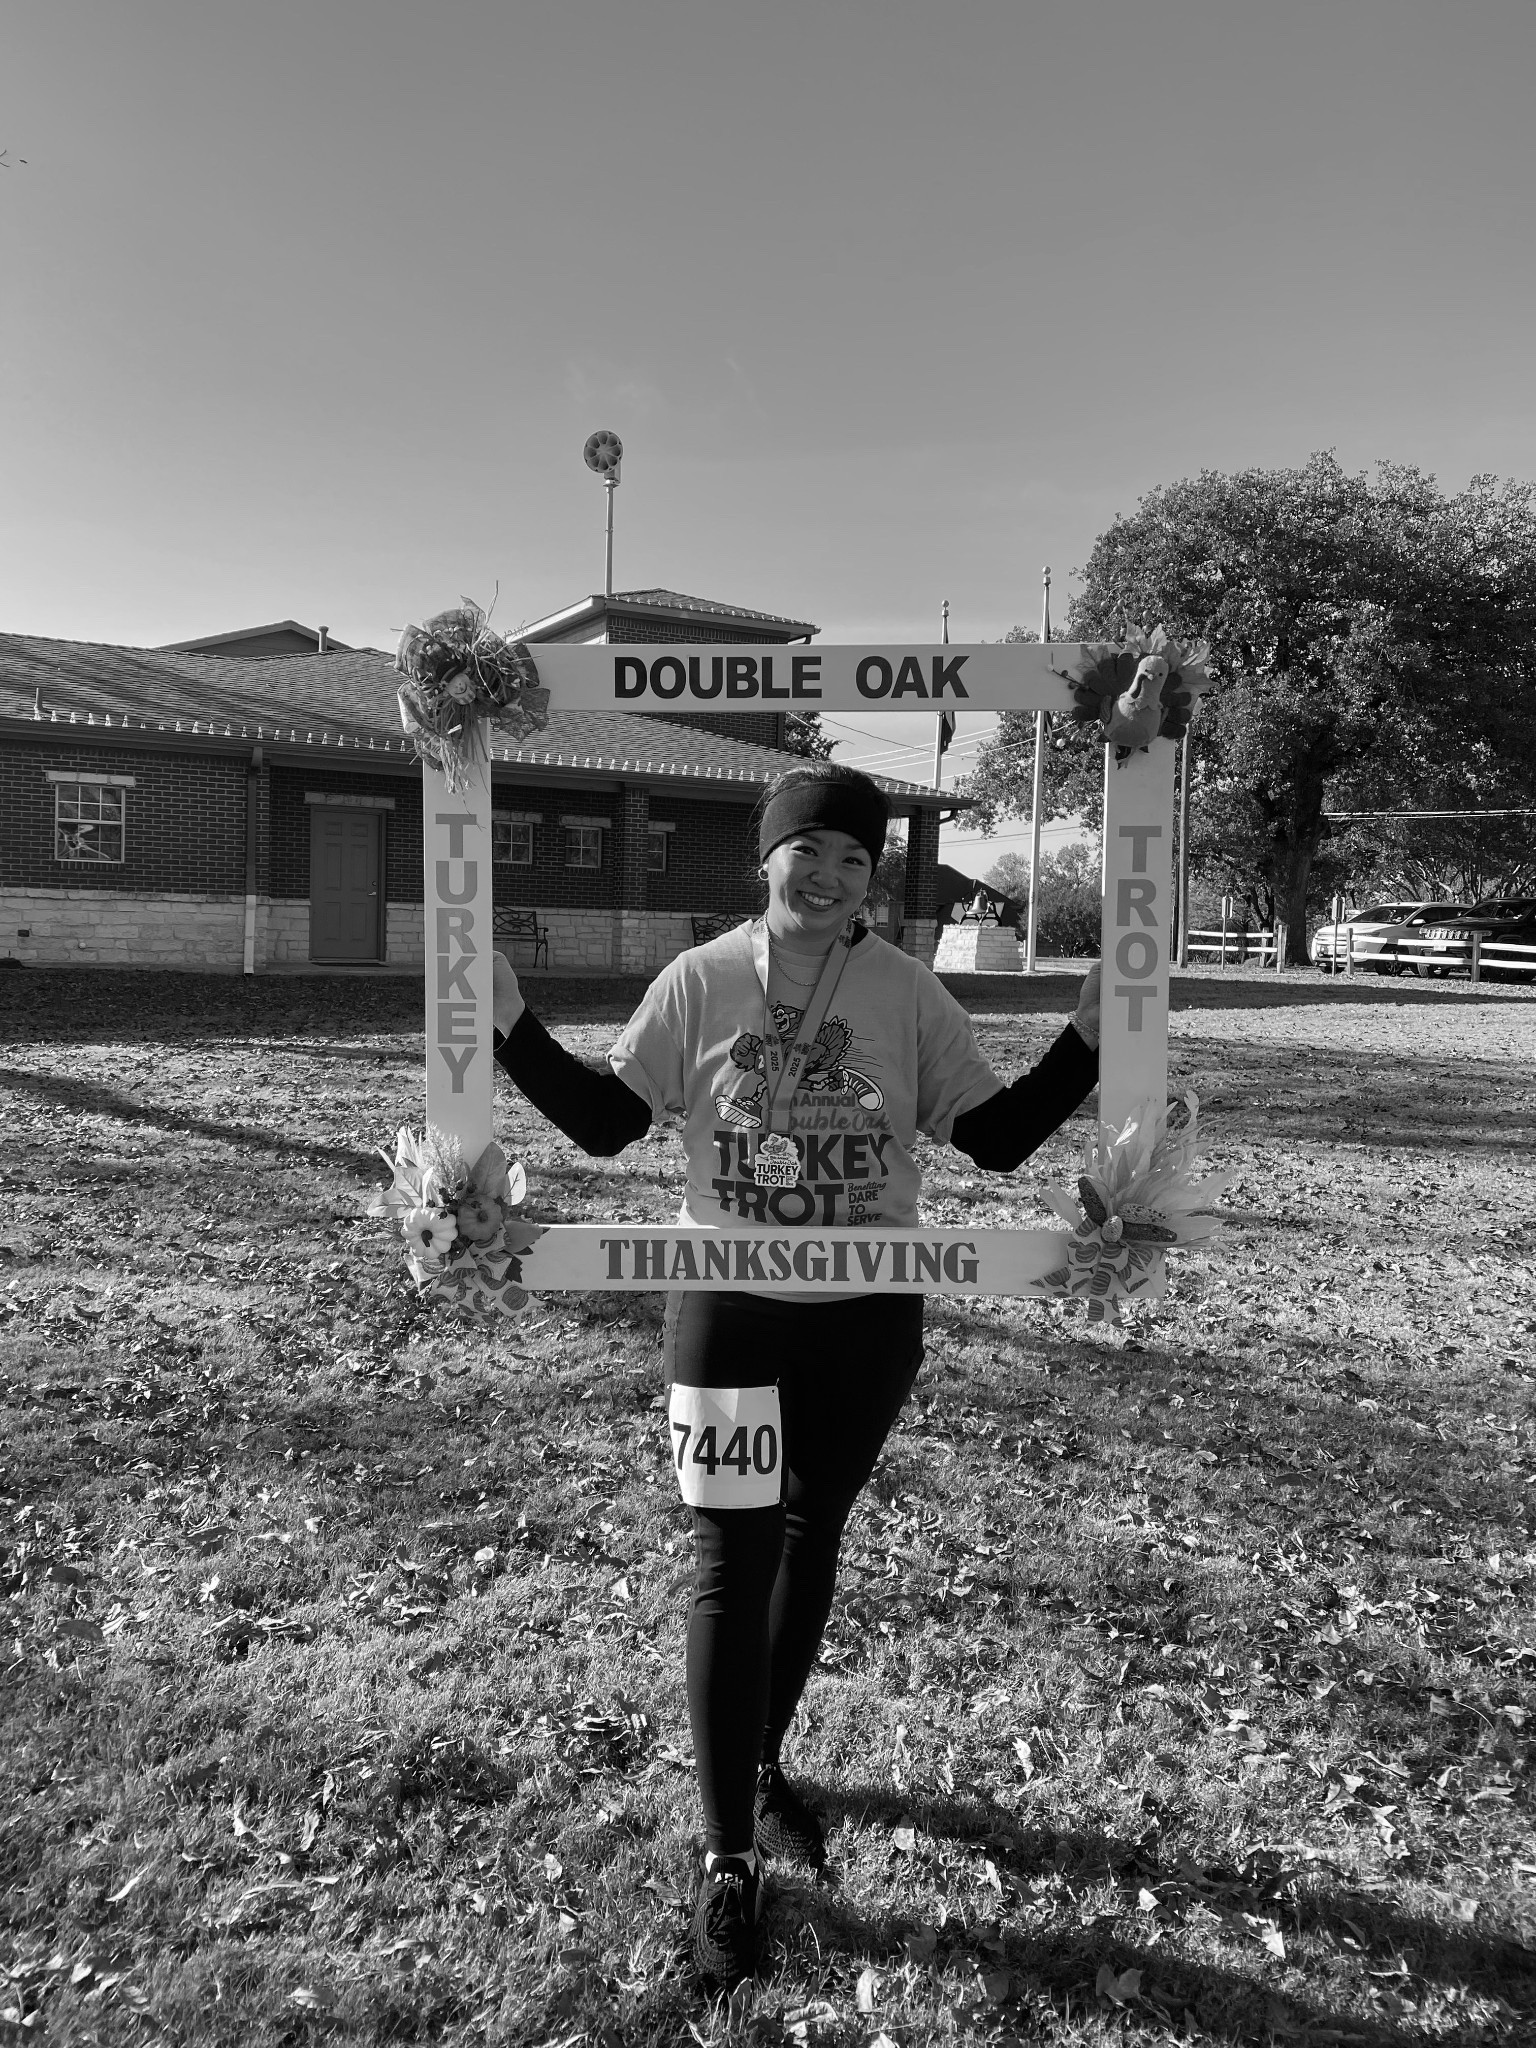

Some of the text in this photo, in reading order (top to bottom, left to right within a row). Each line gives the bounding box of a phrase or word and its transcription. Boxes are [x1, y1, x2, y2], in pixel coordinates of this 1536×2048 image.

[614, 655, 970, 699] DOUBLE OAK
[1114, 825, 1162, 1031] TROT
[435, 813, 478, 1094] TURKEY
[770, 1050, 780, 1072] 2025
[788, 1057, 801, 1077] 2025
[800, 1093, 856, 1108] Annual
[790, 1107, 892, 1133] ouble Oak
[757, 1163, 799, 1176] TURKEY
[757, 1174, 786, 1186] TROT
[847, 1181, 887, 1192] Benefiting
[848, 1190, 879, 1204] DARE
[712, 1178, 844, 1226] TROT
[848, 1204, 866, 1215] TO
[847, 1213, 882, 1226] SERVE
[600, 1239, 979, 1284] THANKSGIVING
[672, 1422, 778, 1476] 7440
